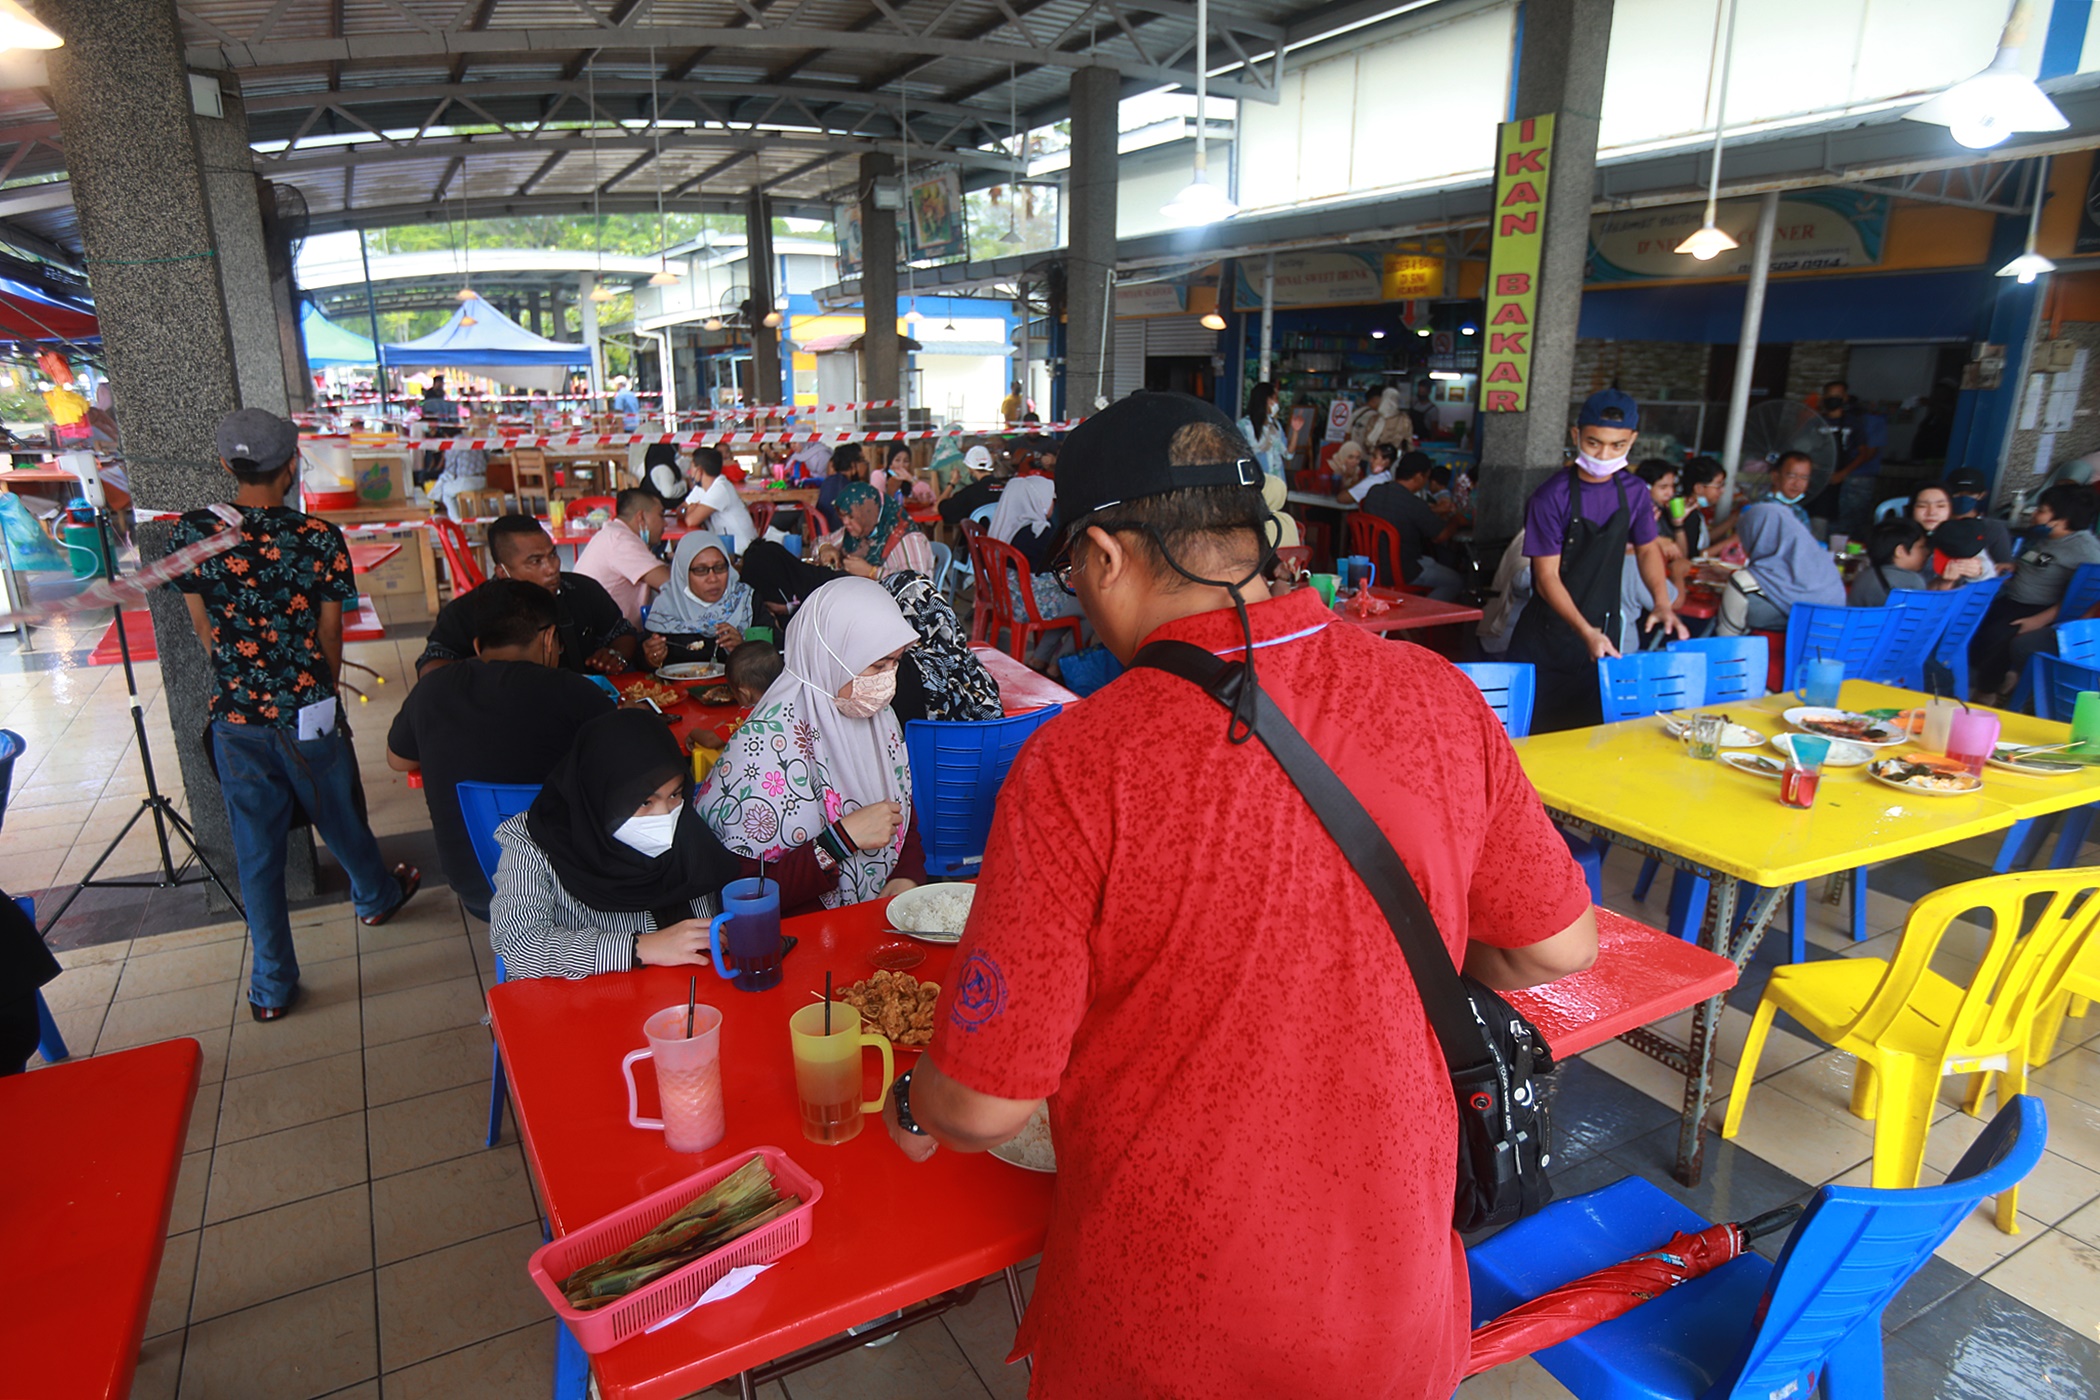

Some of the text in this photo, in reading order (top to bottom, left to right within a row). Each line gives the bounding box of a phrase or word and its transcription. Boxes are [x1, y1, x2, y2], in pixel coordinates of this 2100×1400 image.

[1304, 271, 1335, 284] SWEET
[1337, 269, 1369, 282] DRINK
[1486, 118, 1547, 412] IKAN BAKAR
